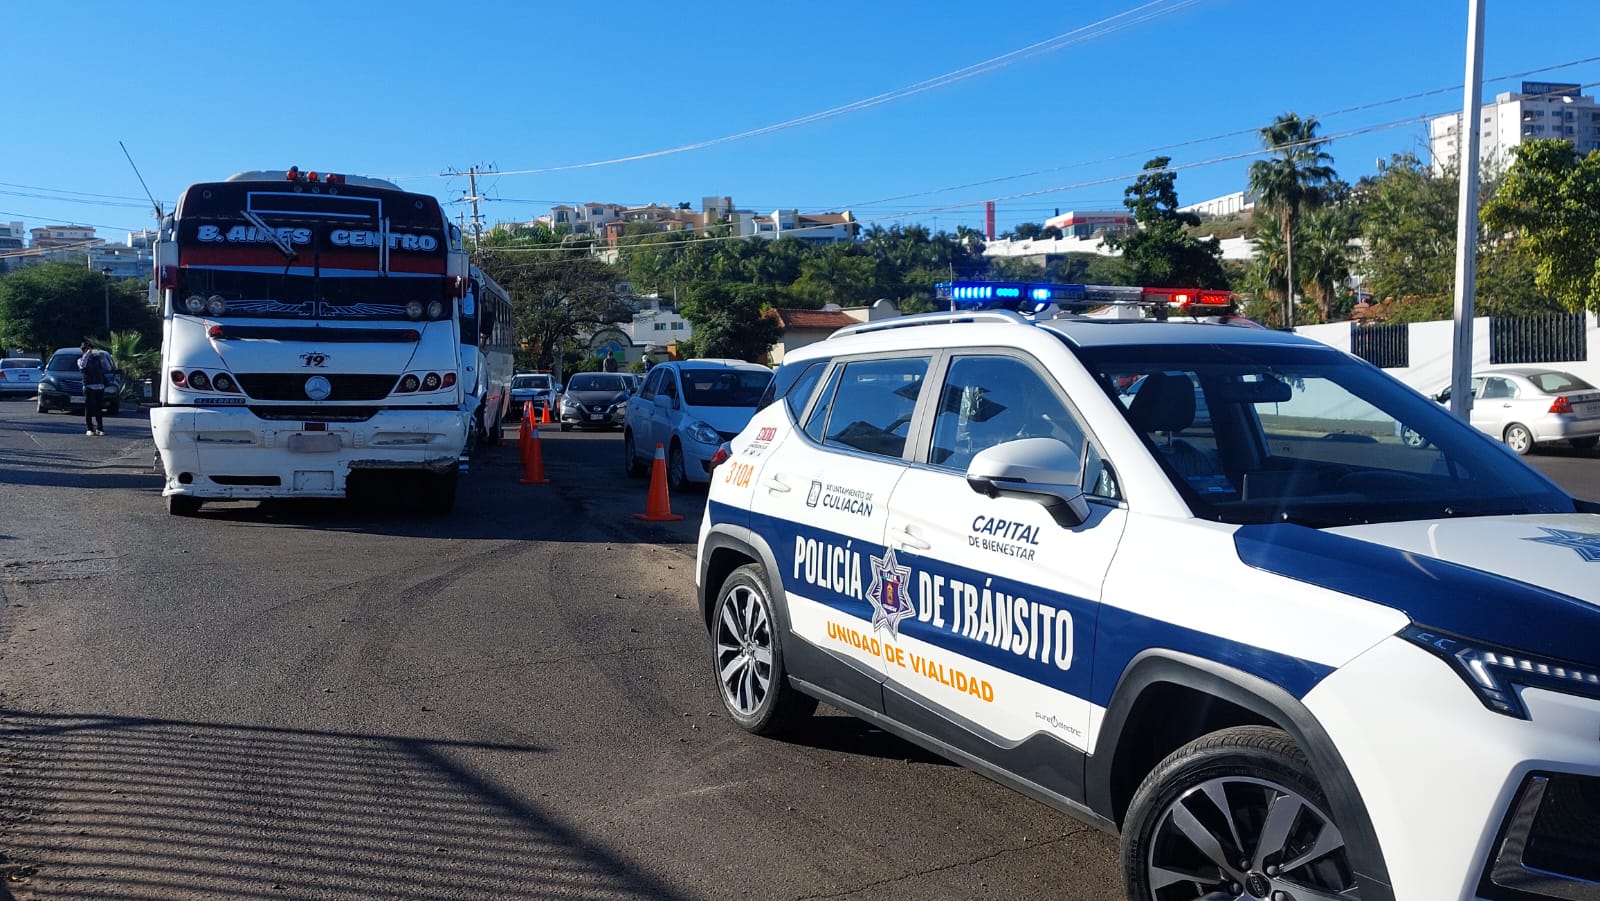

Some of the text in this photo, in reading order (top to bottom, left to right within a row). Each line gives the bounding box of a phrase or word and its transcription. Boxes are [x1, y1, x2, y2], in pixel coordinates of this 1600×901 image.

[330, 229, 438, 251] CENTRO
[304, 355, 325, 367] 19
[972, 515, 1040, 545] CAPITAL
[968, 535, 1036, 561] DE BIENESTAR
[793, 535, 1074, 671] POLICÍA DE TRÁNSITO
[827, 620, 994, 703] UNIDAD DE VIALIDAD
